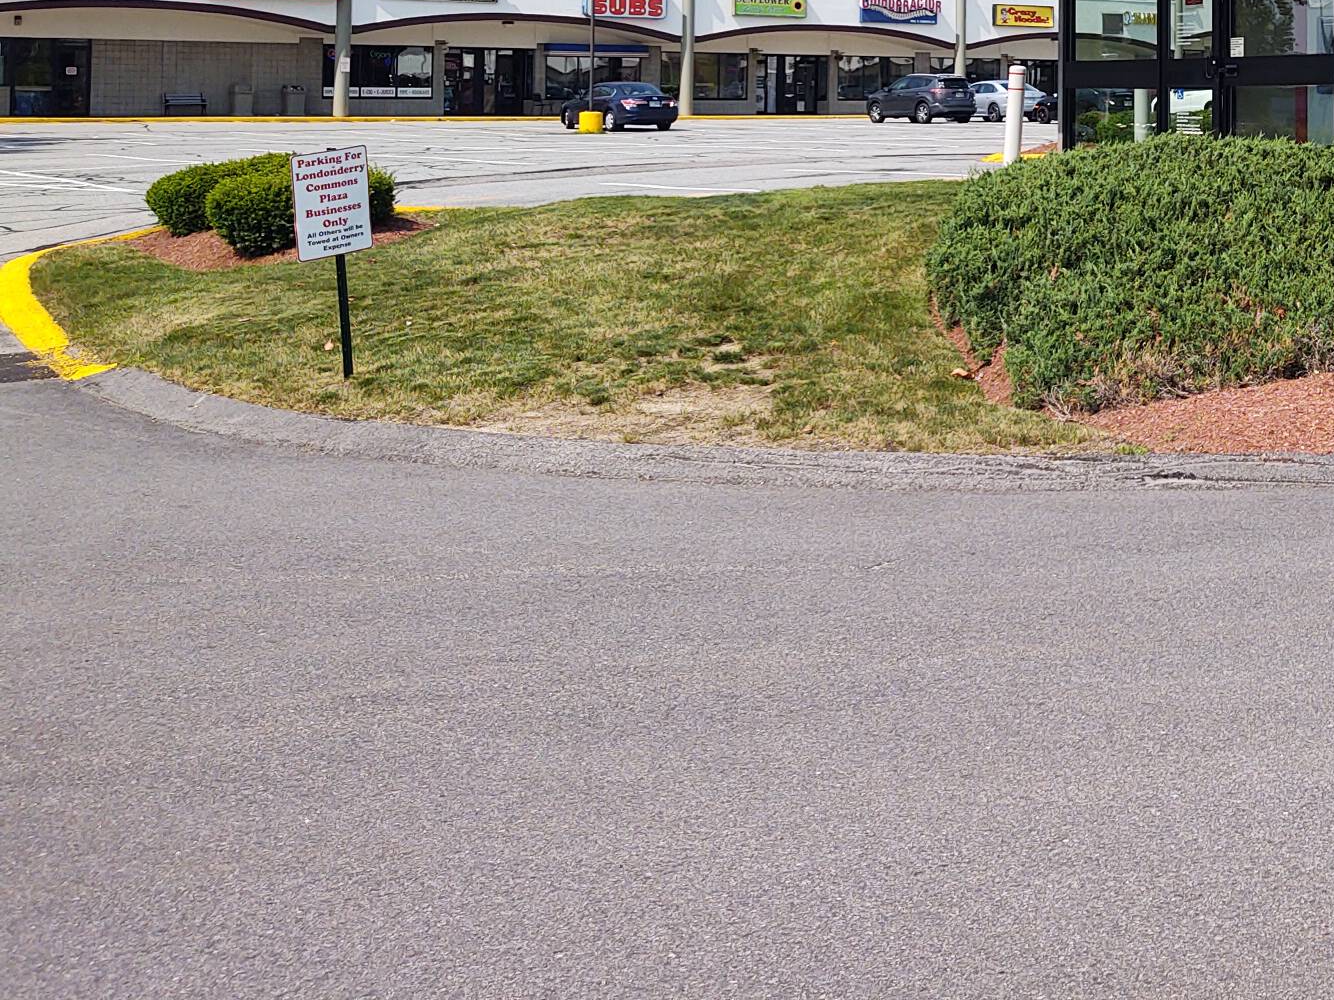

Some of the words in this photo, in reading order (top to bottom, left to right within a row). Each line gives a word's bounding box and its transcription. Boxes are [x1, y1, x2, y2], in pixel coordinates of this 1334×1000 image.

[297, 156, 342, 168] Parking
[344, 151, 362, 161] For
[295, 164, 365, 181] Londonderry
[305, 178, 359, 192] Commons
[319, 192, 349, 203] Plaza
[305, 202, 362, 218] Businesses
[322, 217, 349, 228] Only
[307, 231, 317, 239] All
[318, 228, 342, 237] Others
[307, 238, 331, 247] Towed
[340, 231, 364, 241] Owners
[323, 242, 352, 251] Expense
